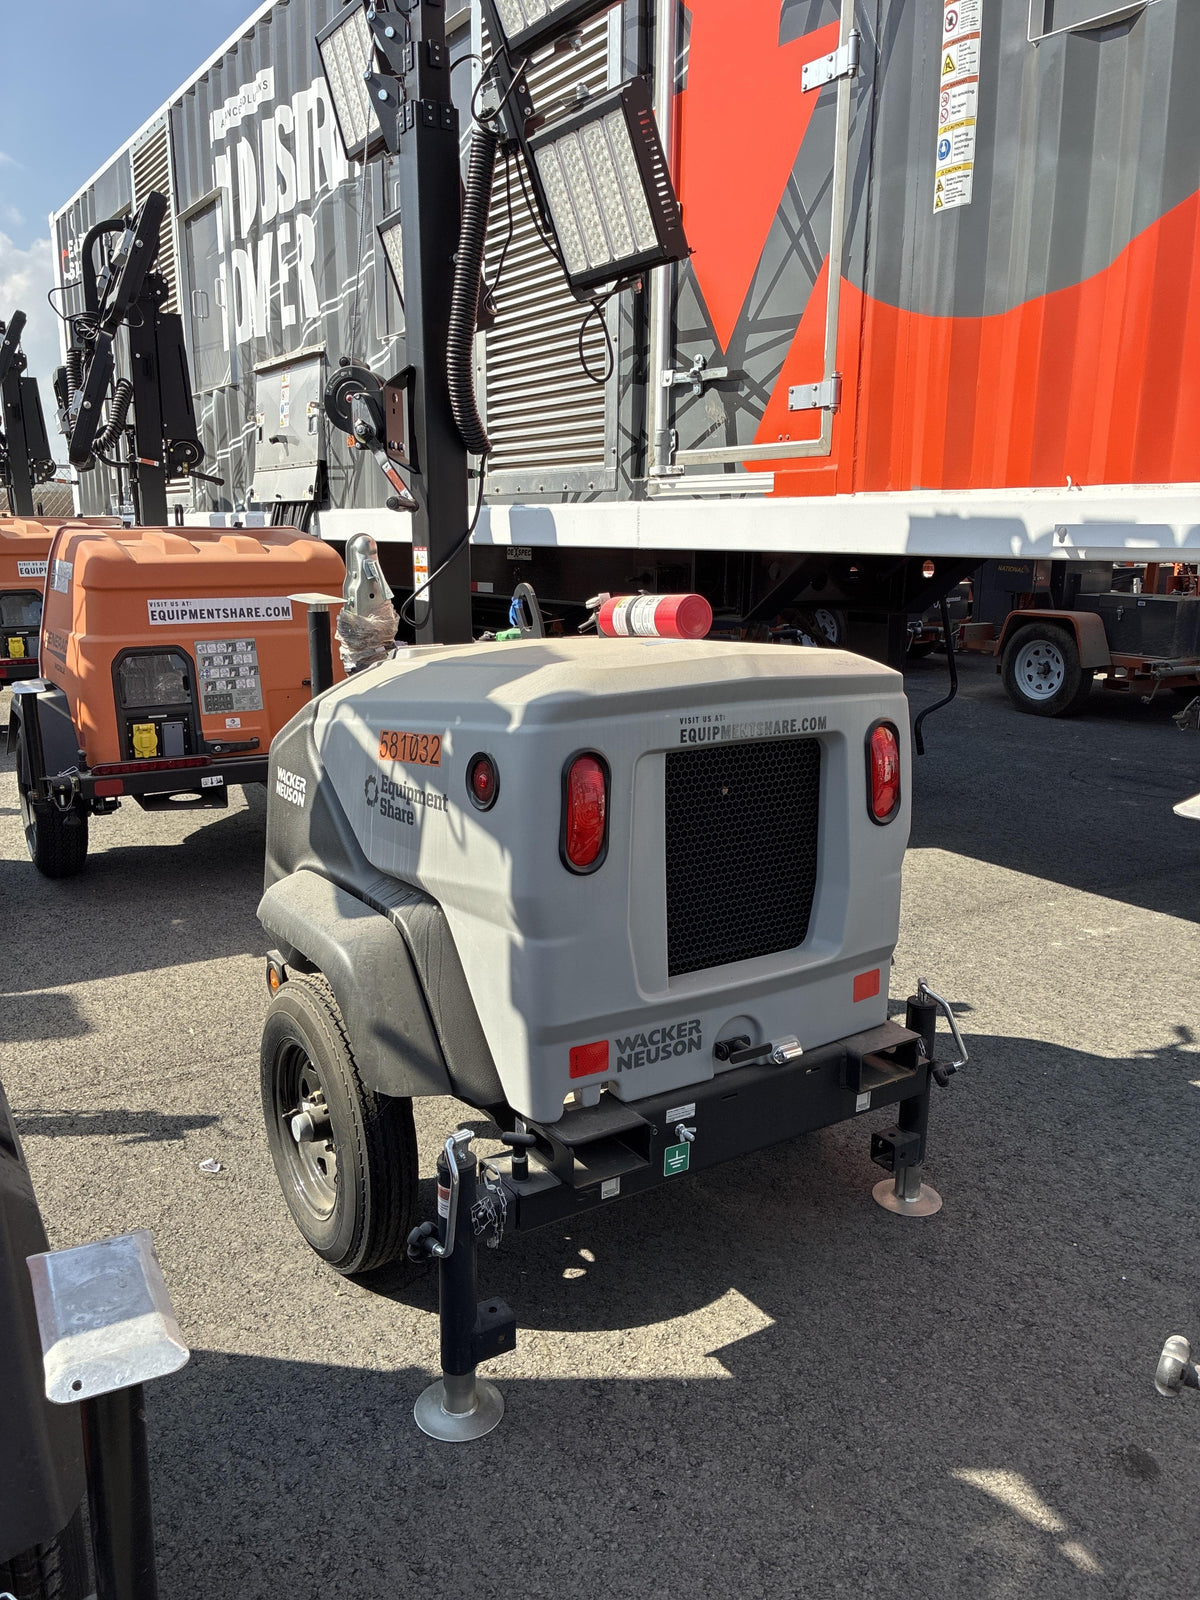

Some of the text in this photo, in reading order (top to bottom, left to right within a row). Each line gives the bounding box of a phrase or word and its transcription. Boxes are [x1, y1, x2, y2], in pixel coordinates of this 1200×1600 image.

[150, 606, 291, 622] EQUIPMENTSHARE.COM
[680, 717, 699, 725] VISIT
[702, 715, 712, 723] US
[680, 716, 828, 744] EQUIPMENTSHARE.COM
[379, 731, 440, 765] 581032
[277, 765, 307, 793] WACKER
[276, 780, 306, 808] NEUSON
[380, 774, 449, 813] Equipment
[379, 798, 415, 826] Share
[615, 1019, 702, 1054] WACKER
[616, 1035, 702, 1073] NEUSON
